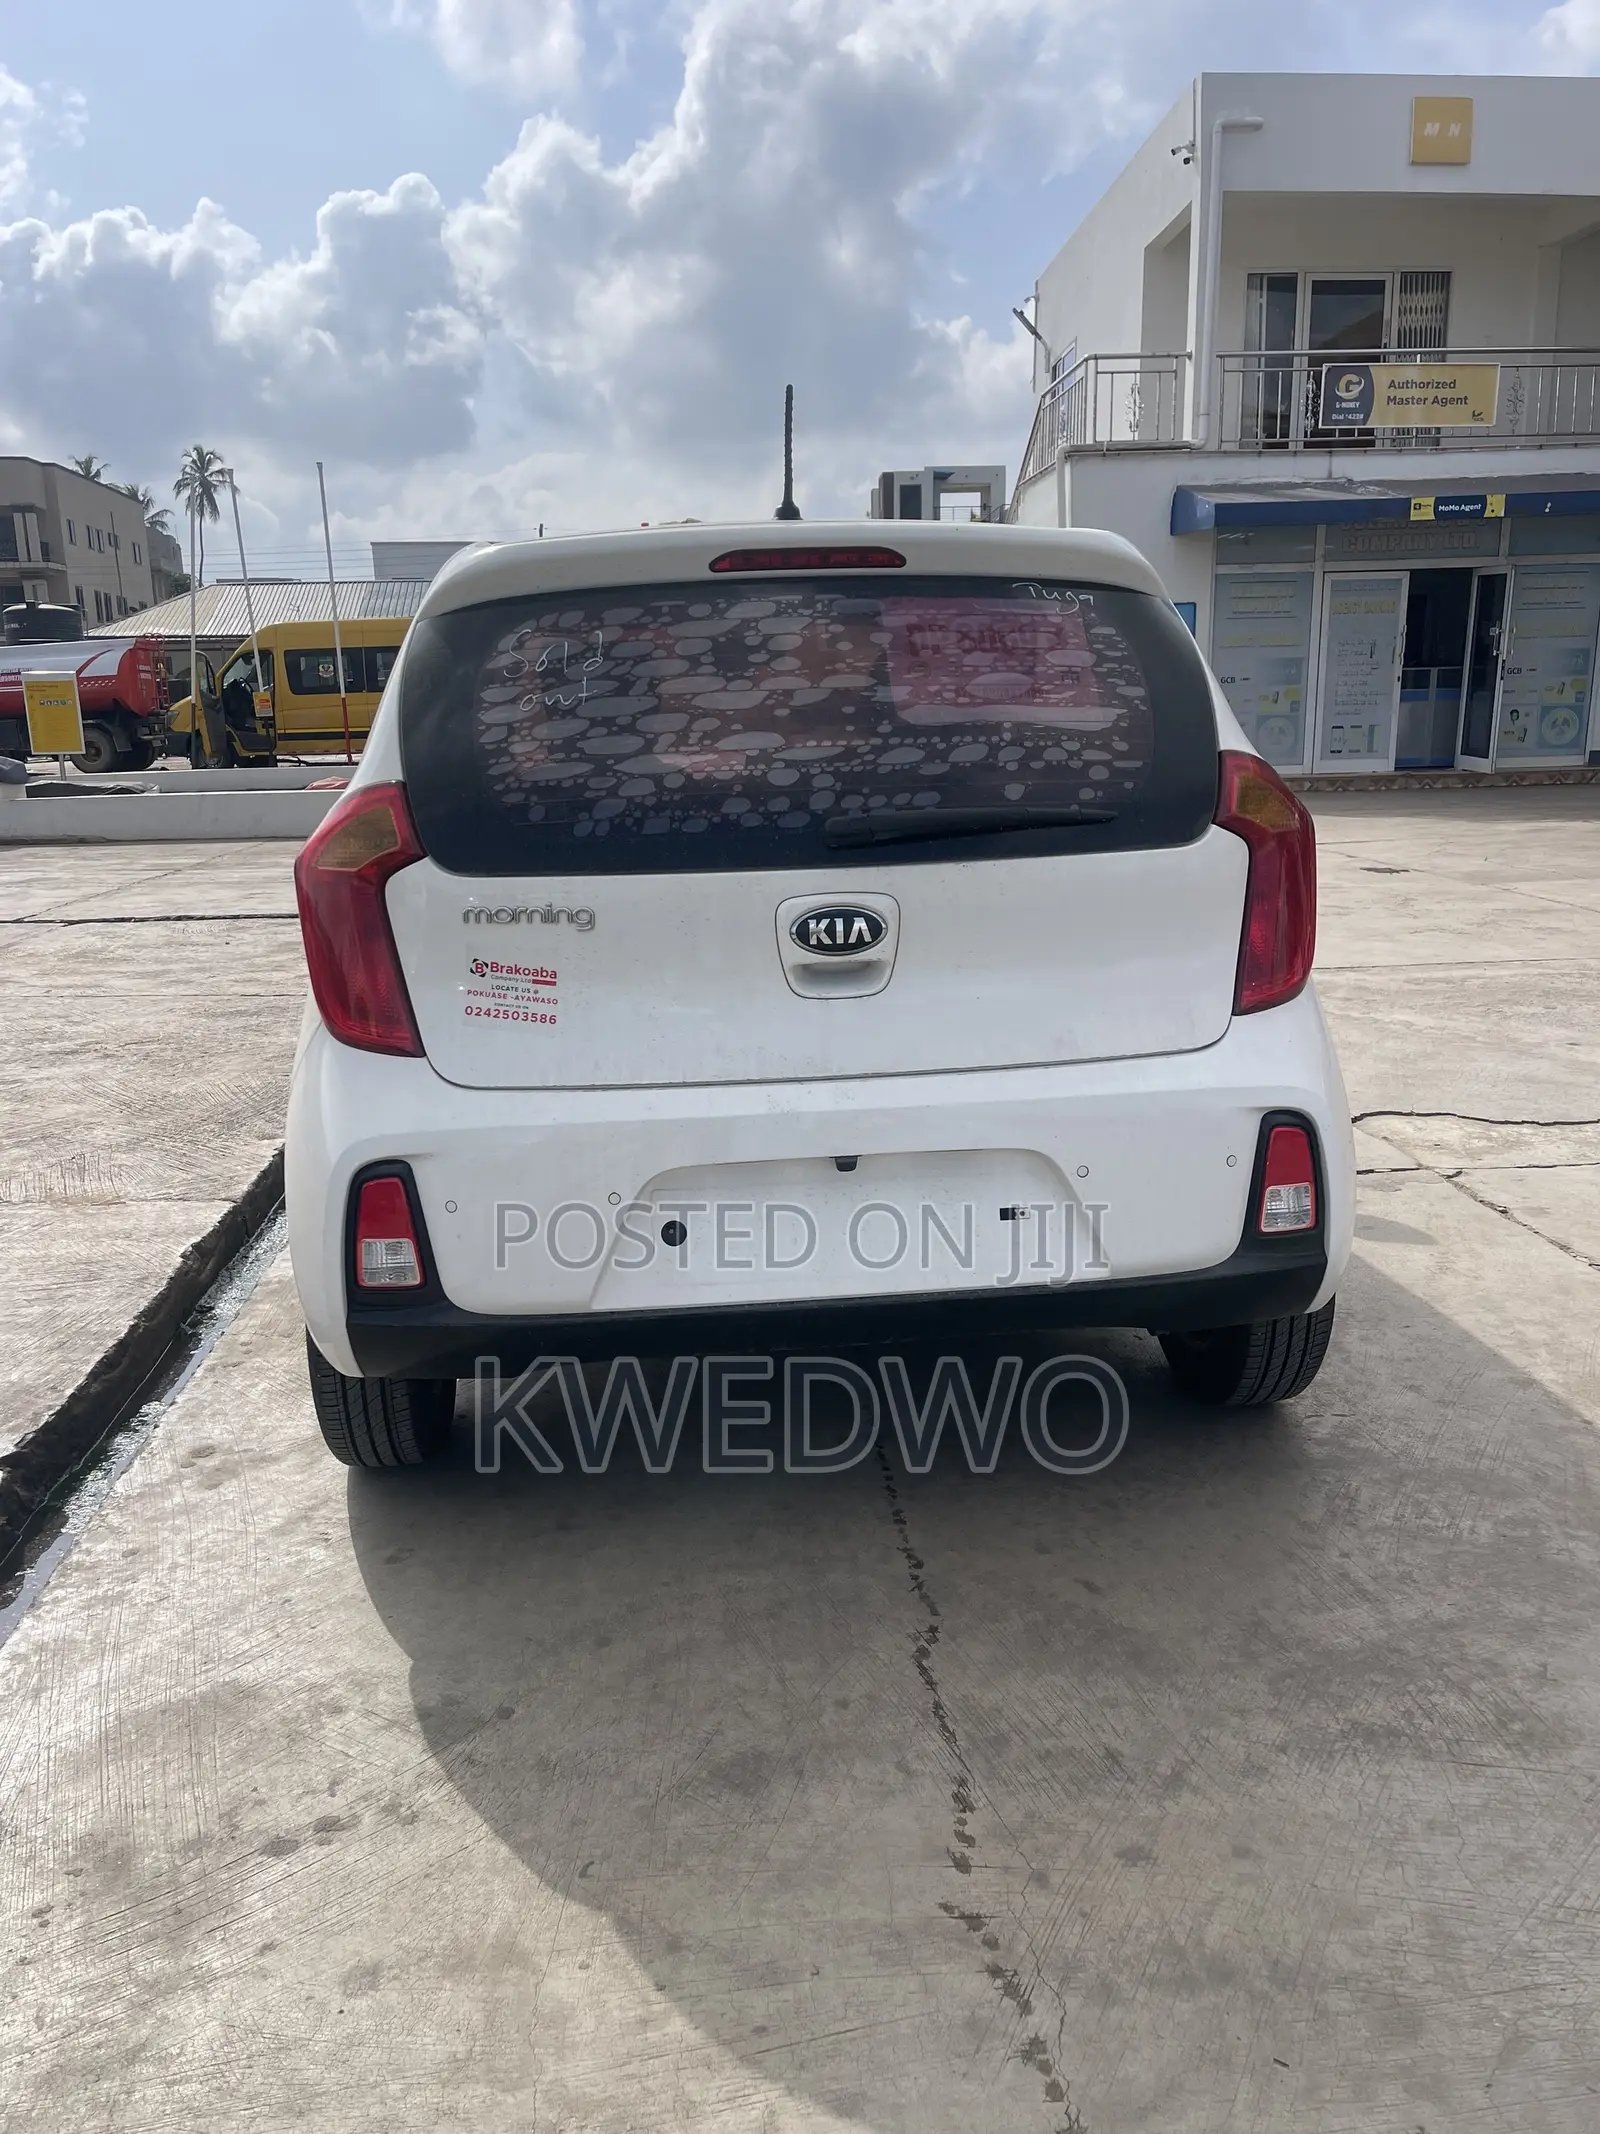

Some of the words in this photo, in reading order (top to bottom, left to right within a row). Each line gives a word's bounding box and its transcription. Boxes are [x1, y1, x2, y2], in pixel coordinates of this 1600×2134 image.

[1387, 379, 1457, 390] Authorized
[1386, 395, 1428, 406] Master
[1431, 395, 1469, 407] Agent
[1438, 503, 1460, 512] MoMo
[1460, 502, 1482, 512] Agent
[1341, 532, 1437, 553] COMPANY
[1506, 667, 1522, 675] GCB
[1220, 676, 1236, 685] GCB
[462, 902, 596, 932] morning
[807, 916, 873, 945] KIA
[490, 961, 558, 980] Brakoaba
[491, 984, 519, 992] LOCATE
[466, 989, 508, 1000] POKUASE
[464, 1005, 557, 1025] 0242503586
